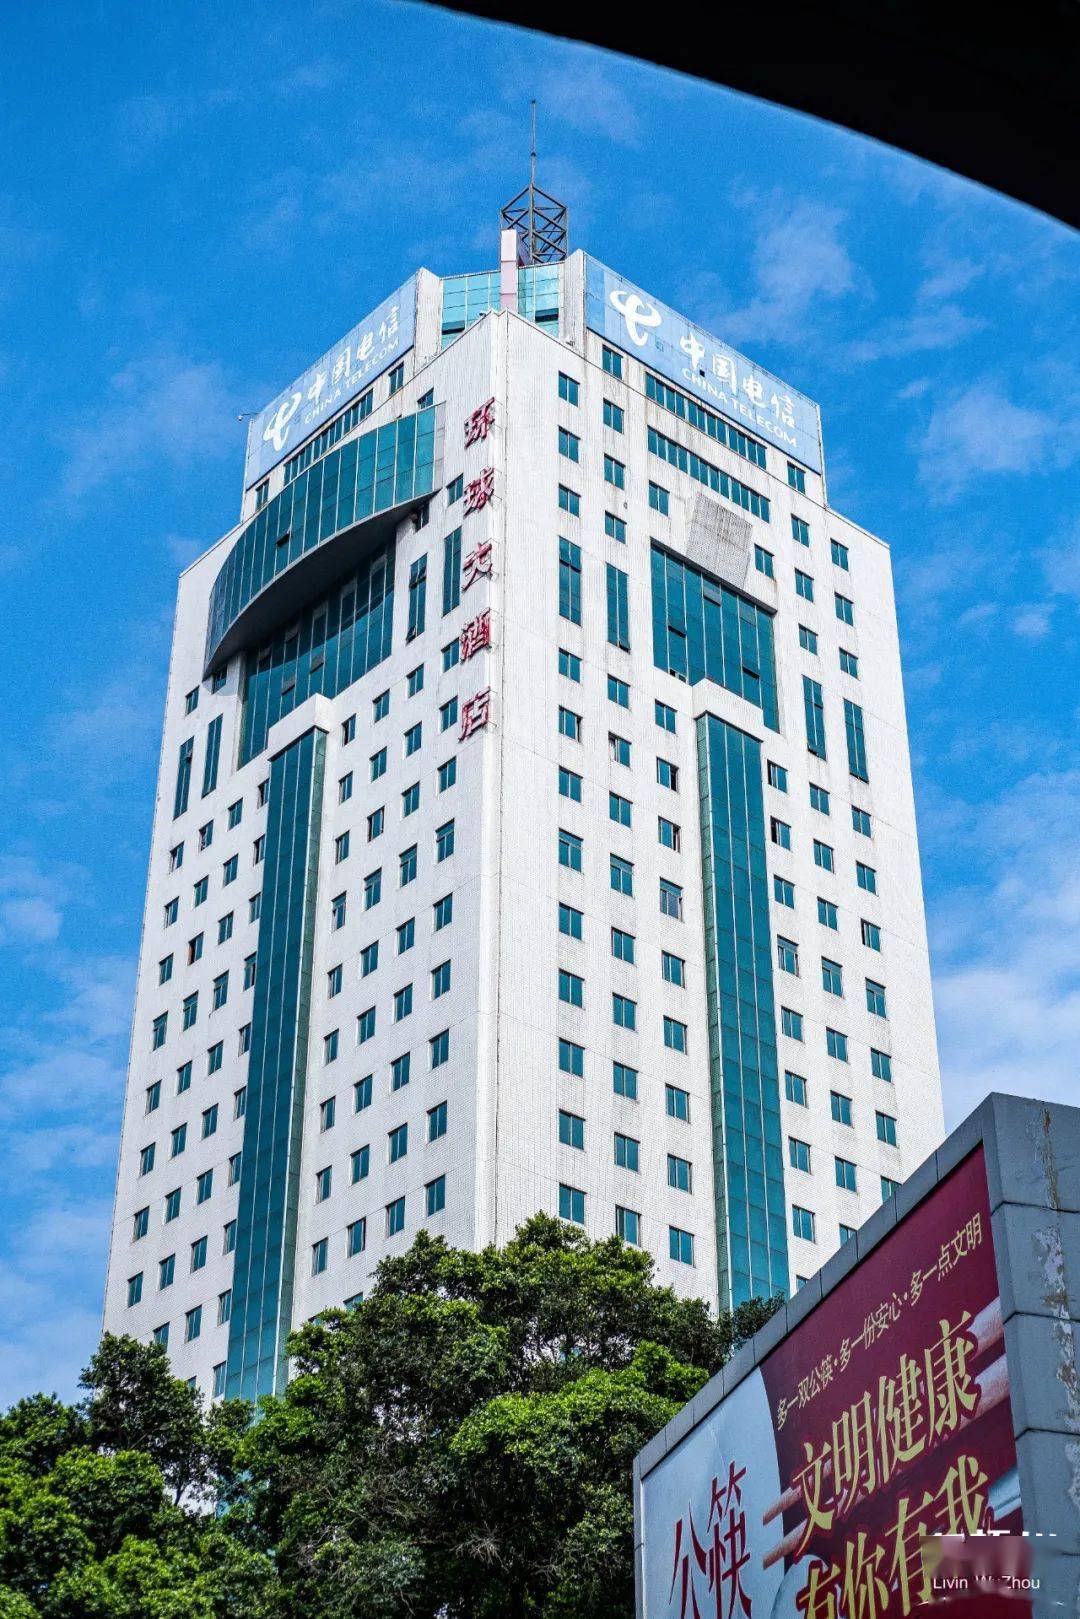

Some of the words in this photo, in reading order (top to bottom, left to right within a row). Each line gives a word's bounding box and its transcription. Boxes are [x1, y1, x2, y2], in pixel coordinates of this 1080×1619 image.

[305, 389, 341, 424] CHINA
[679, 332, 795, 429] 中国电信
[681, 367, 728, 404] CHINA
[730, 397, 798, 448] TELECOM
[792, 1311, 979, 1557] 文明健康
